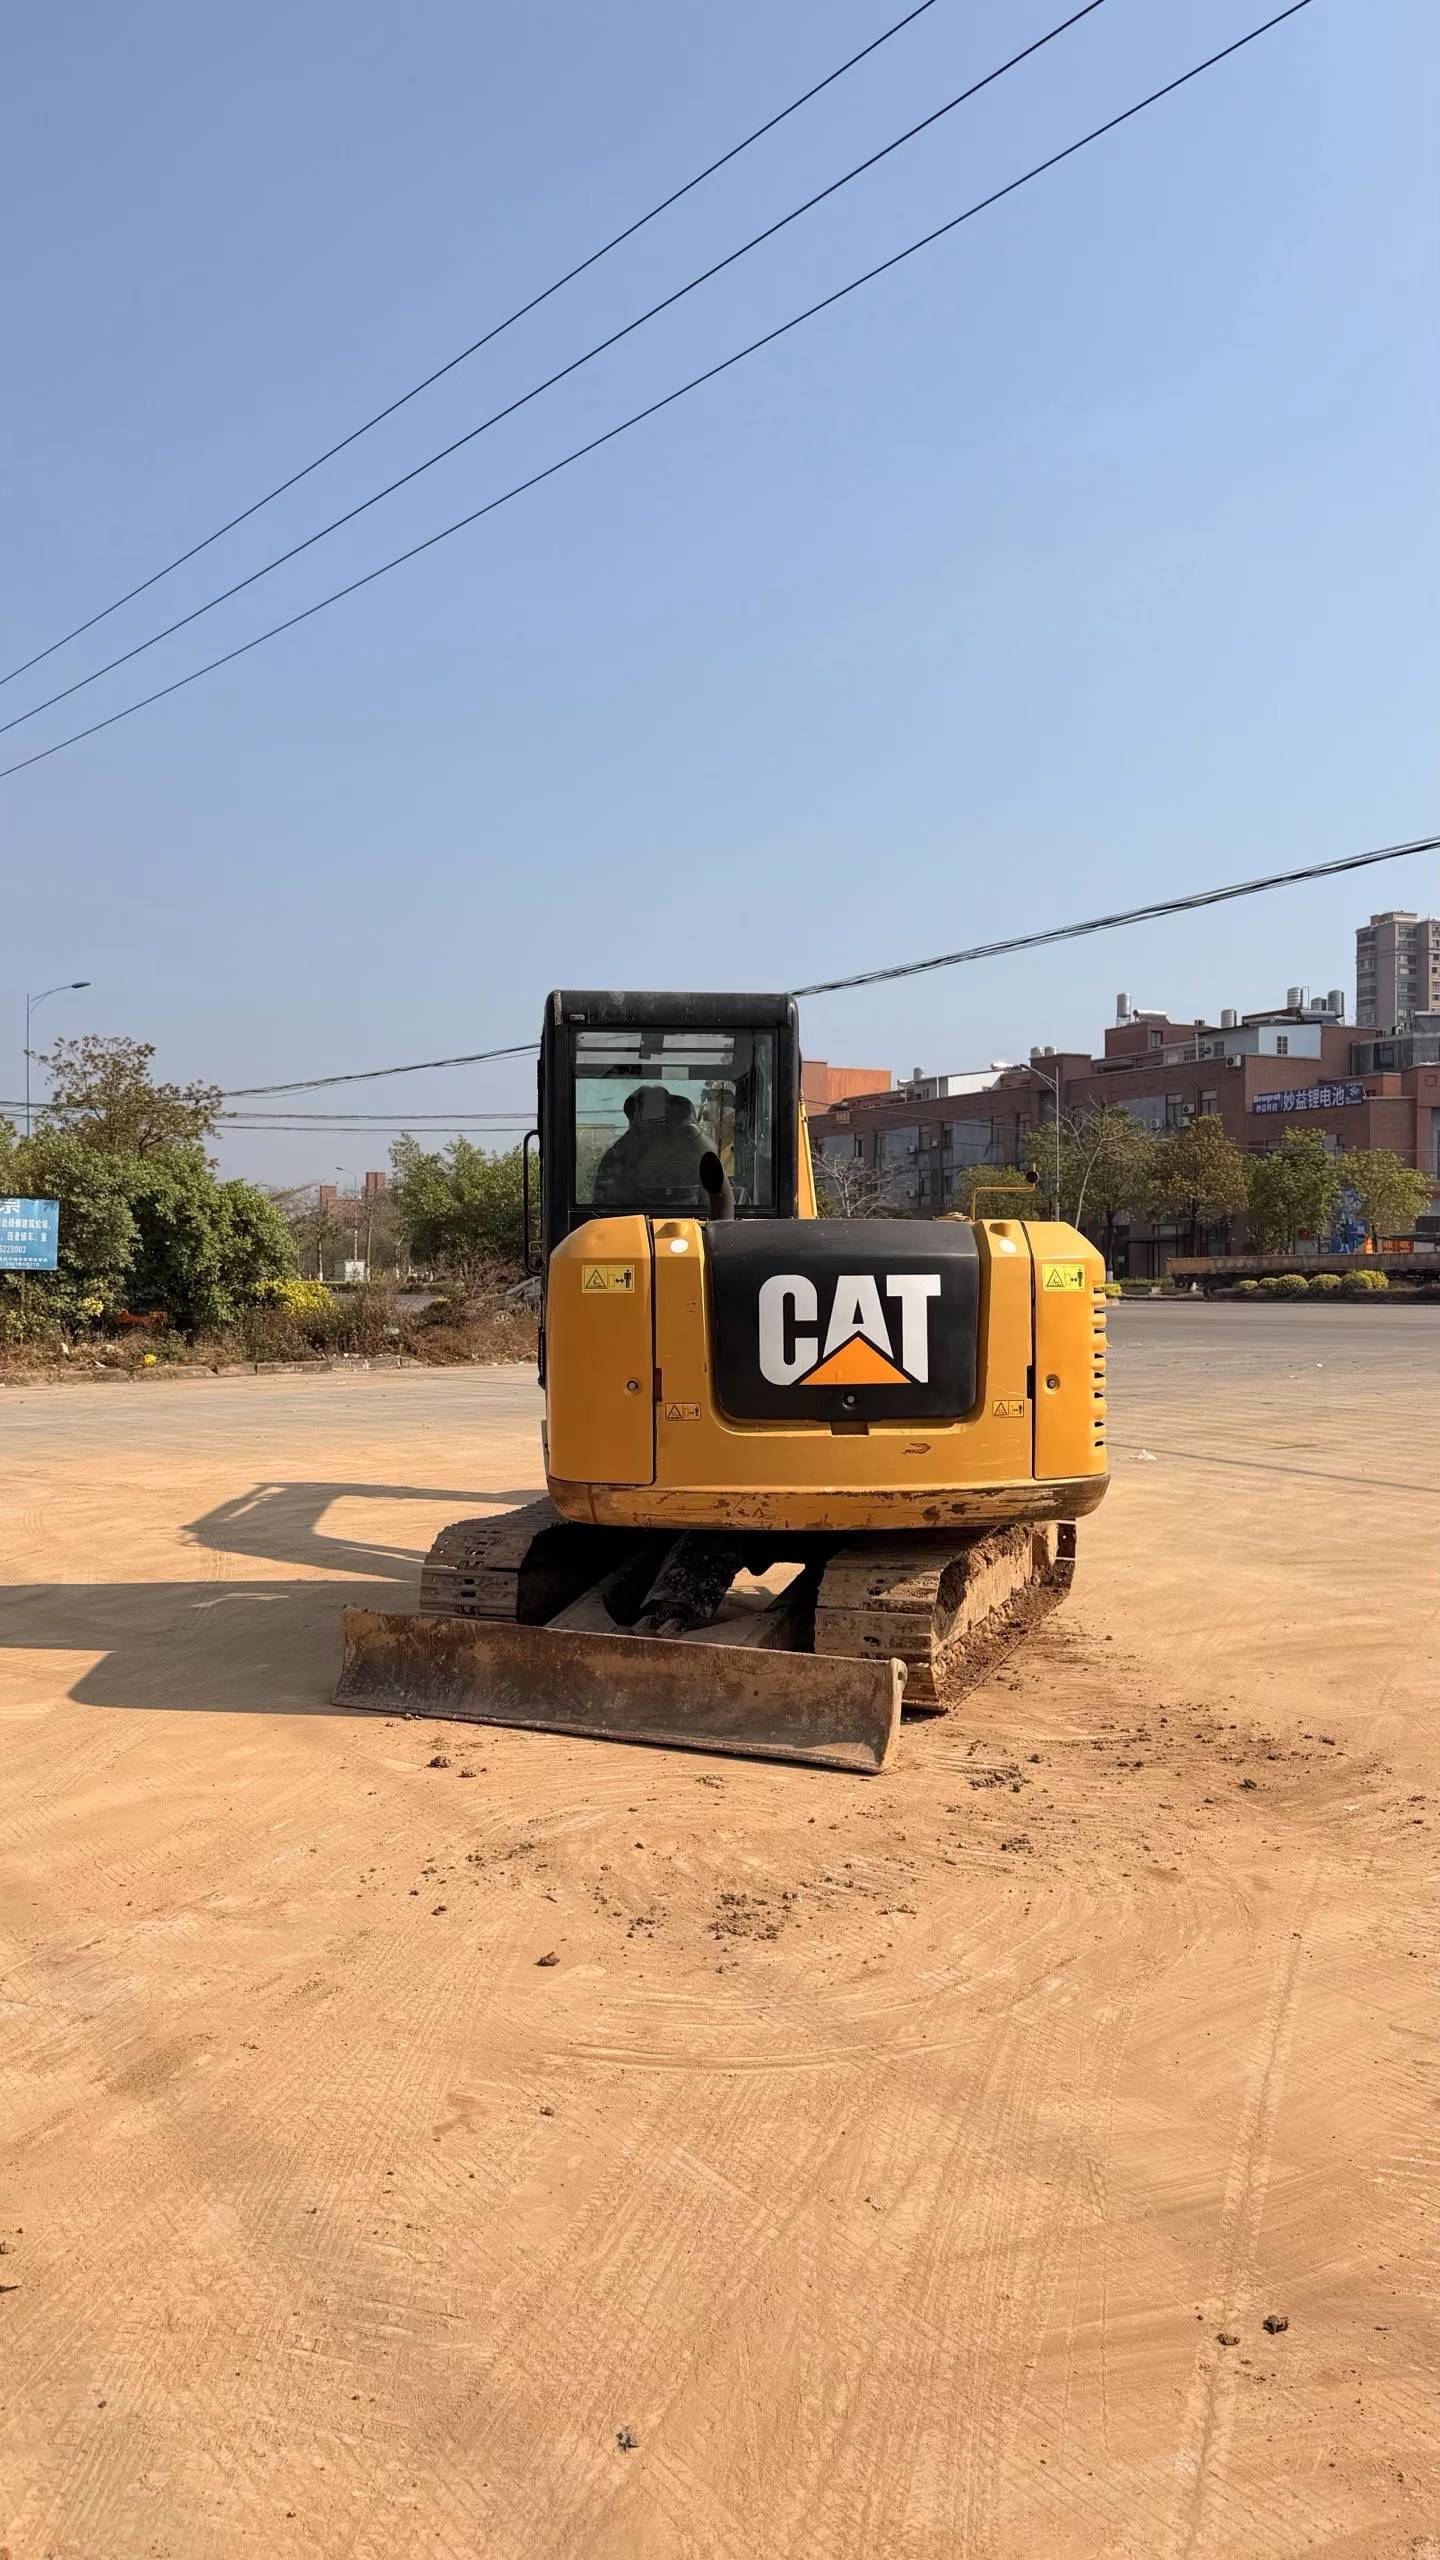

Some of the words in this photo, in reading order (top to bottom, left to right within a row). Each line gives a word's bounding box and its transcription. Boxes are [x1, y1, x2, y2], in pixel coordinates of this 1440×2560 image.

[1282, 1085, 1345, 1112] 妙益锂电池
[759, 1274, 942, 1386] CAT
